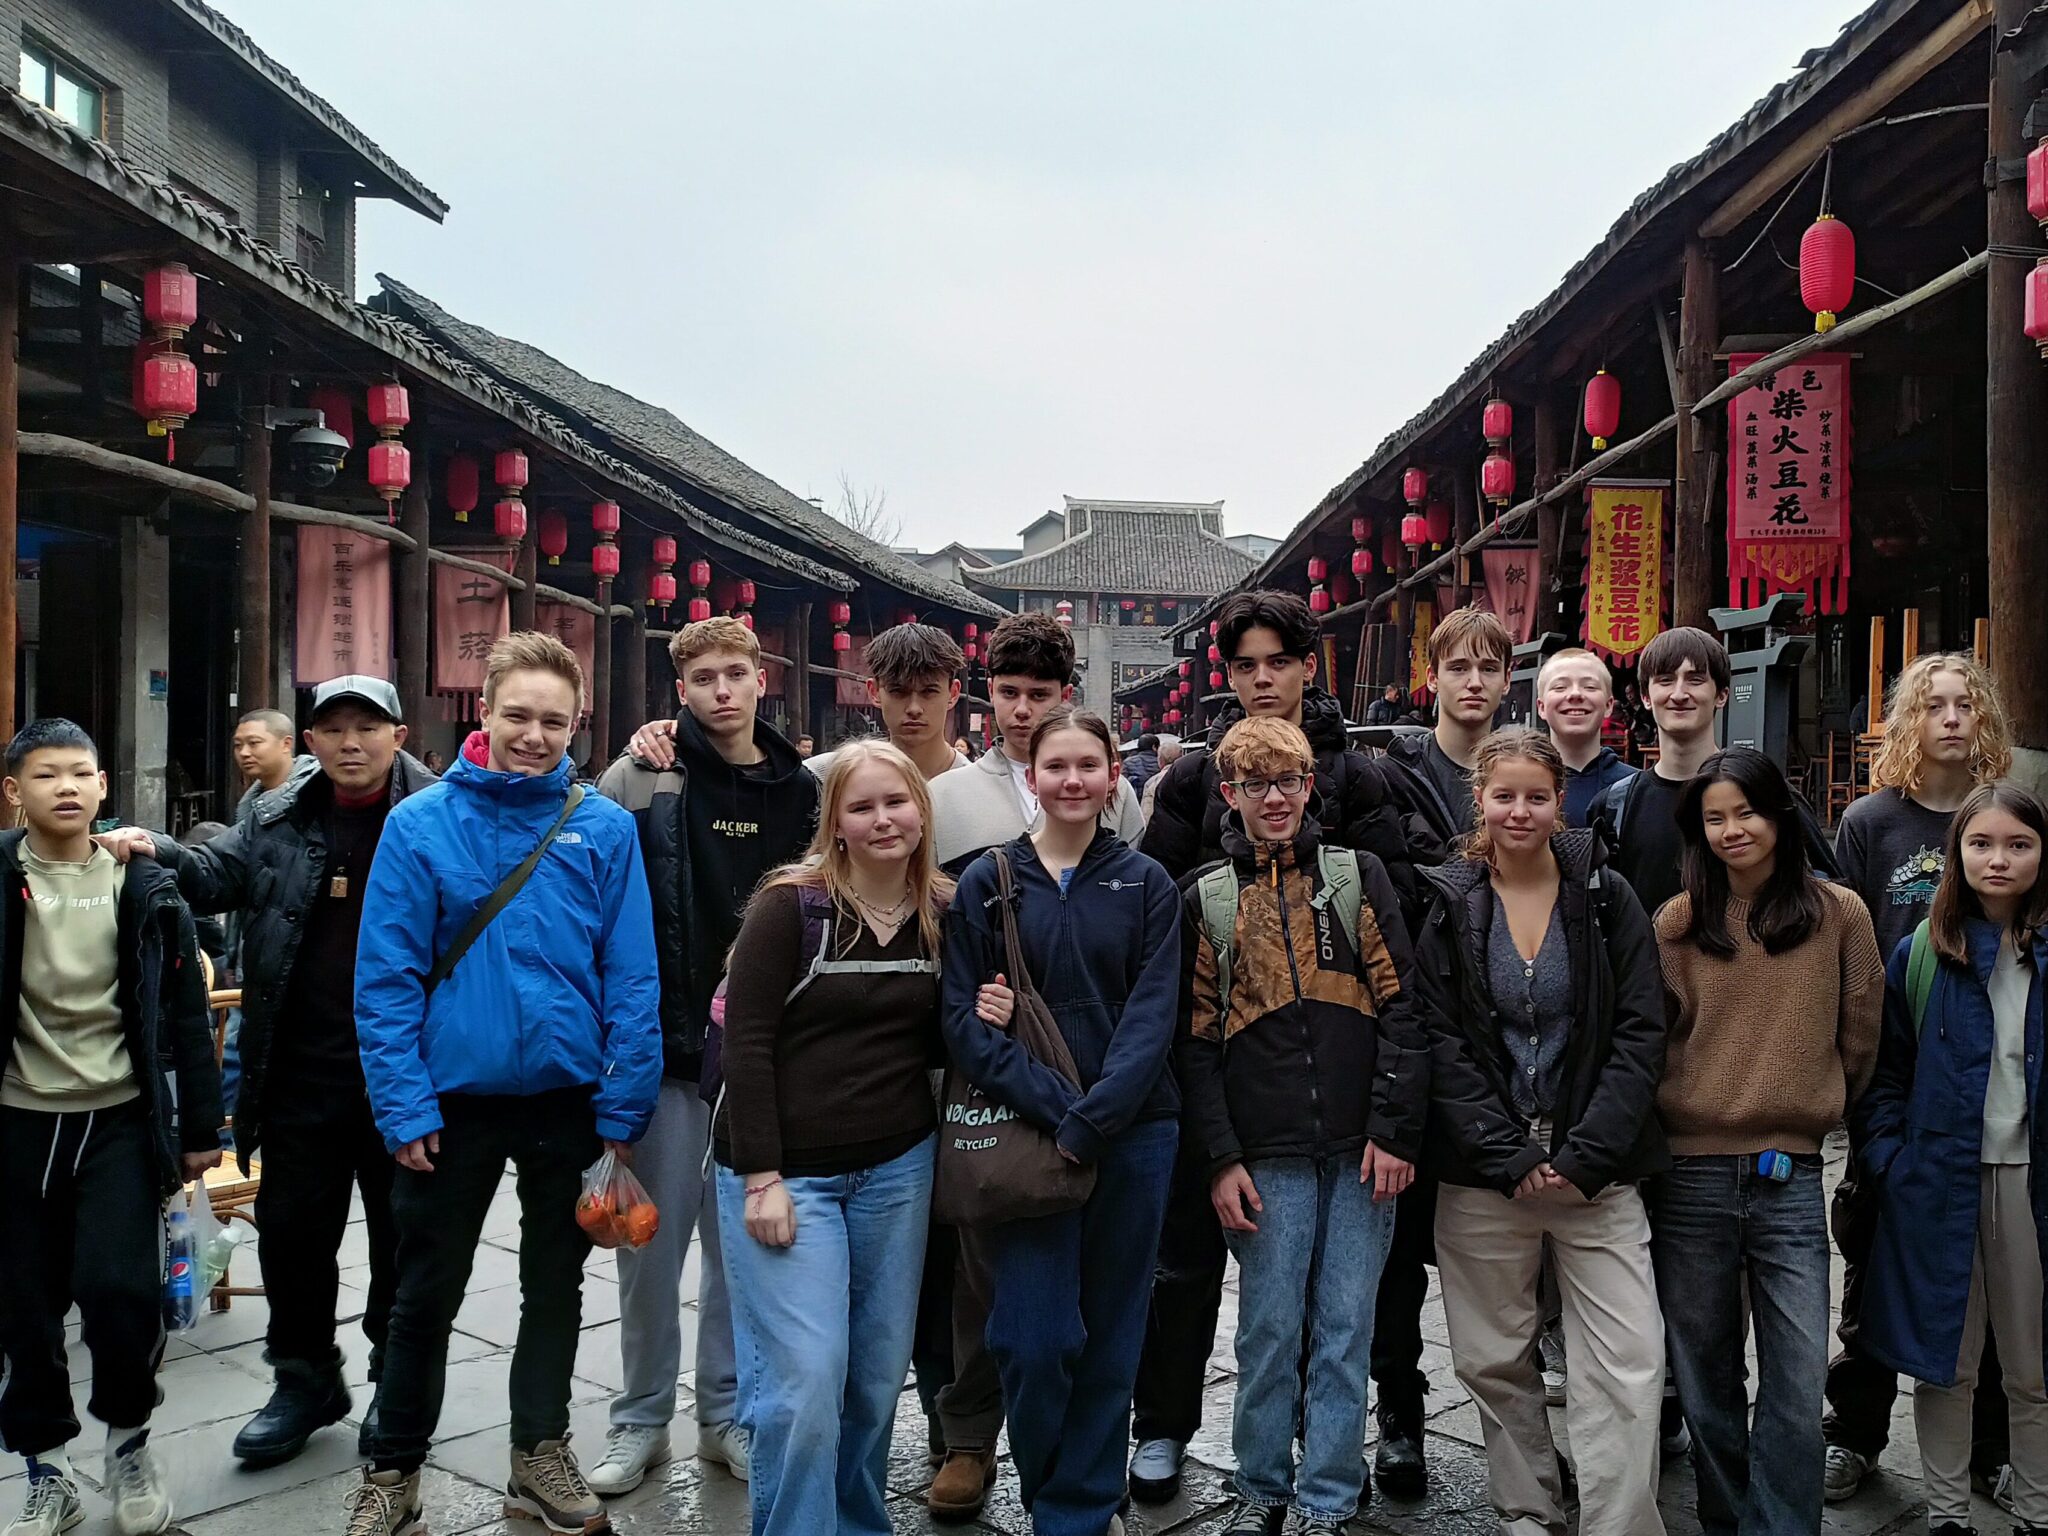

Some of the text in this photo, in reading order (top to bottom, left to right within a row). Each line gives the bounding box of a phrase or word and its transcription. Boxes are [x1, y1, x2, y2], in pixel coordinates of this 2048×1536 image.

[1768, 388, 1809, 526] 柴火豆花
[1608, 503, 1643, 642] 花生浆豆花
[712, 819, 759, 834] JACKER
[953, 1136, 998, 1151] RECYCLED
